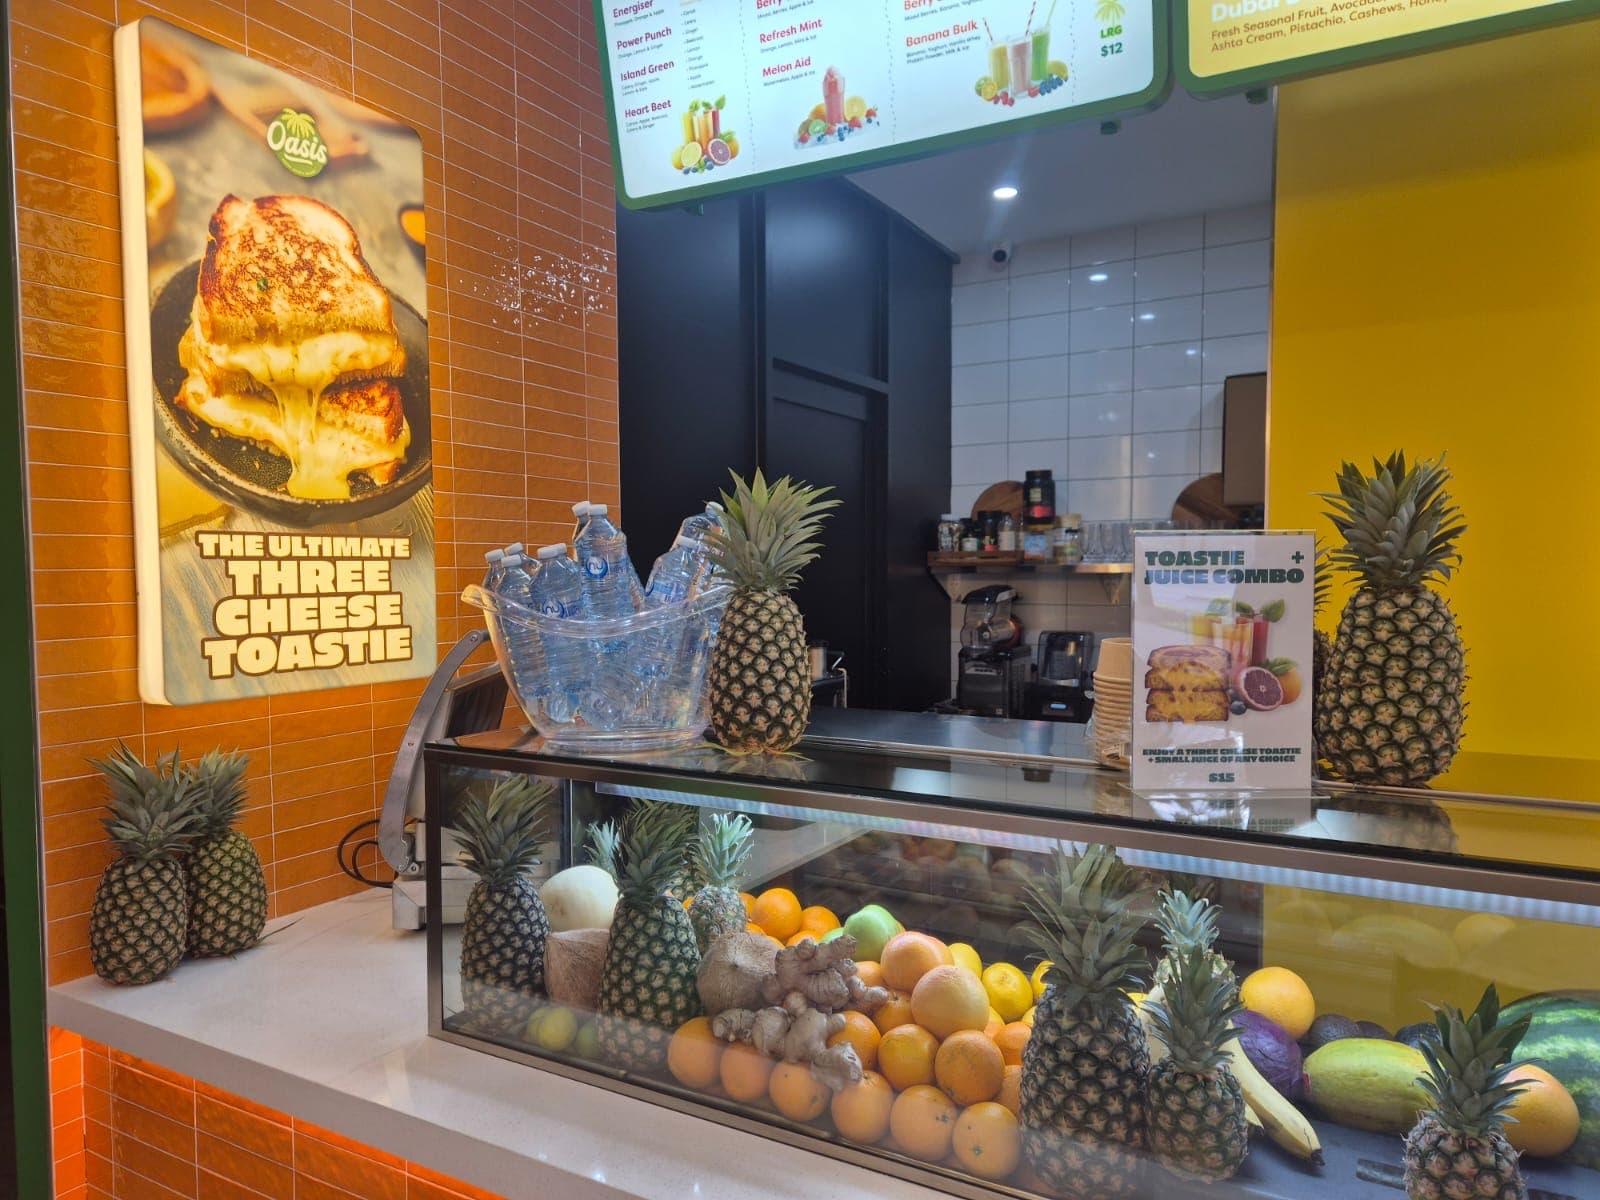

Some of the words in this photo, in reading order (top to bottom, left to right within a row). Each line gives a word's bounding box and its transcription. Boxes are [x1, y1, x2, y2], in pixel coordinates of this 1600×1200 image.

[613, 0, 653, 18] Energiser
[759, 25, 797, 44] Refresh
[799, 19, 822, 33] Mint
[906, 29, 950, 47] Banana
[953, 20, 979, 35] Bulk
[1100, 25, 1122, 39] LRG
[1211, 26, 1241, 40] Fresh
[1243, 12, 1295, 33] Seasonal
[1298, 6, 1327, 20] Fruit,
[1211, 39, 1243, 52] Ashta
[1246, 30, 1287, 44] Cream,
[1290, 16, 1346, 34] Pistachio,
[1349, 3, 1405, 21] Cashews,
[617, 35, 643, 50] Power
[645, 26, 672, 42] Punch
[1100, 42, 1123, 57] $12
[620, 66, 647, 82] Island
[648, 60, 674, 74] Green
[763, 63, 793, 77] Melon
[795, 56, 811, 69] Aid
[625, 104, 649, 118] Heart
[651, 99, 672, 112] Beet
[267, 120, 328, 164] Oasis
[197, 532, 264, 557] THE
[268, 534, 411, 558] ULTIMATE
[1145, 551, 1244, 566] TOASTIE
[227, 559, 391, 596] THREE
[1144, 569, 1208, 584] JUICE
[1213, 568, 1305, 584] COMBO
[214, 593, 402, 636] CHEESE
[203, 626, 412, 677] TOASTIE
[1235, 755, 1258, 763] ANY
[1208, 772, 1235, 782] $15
